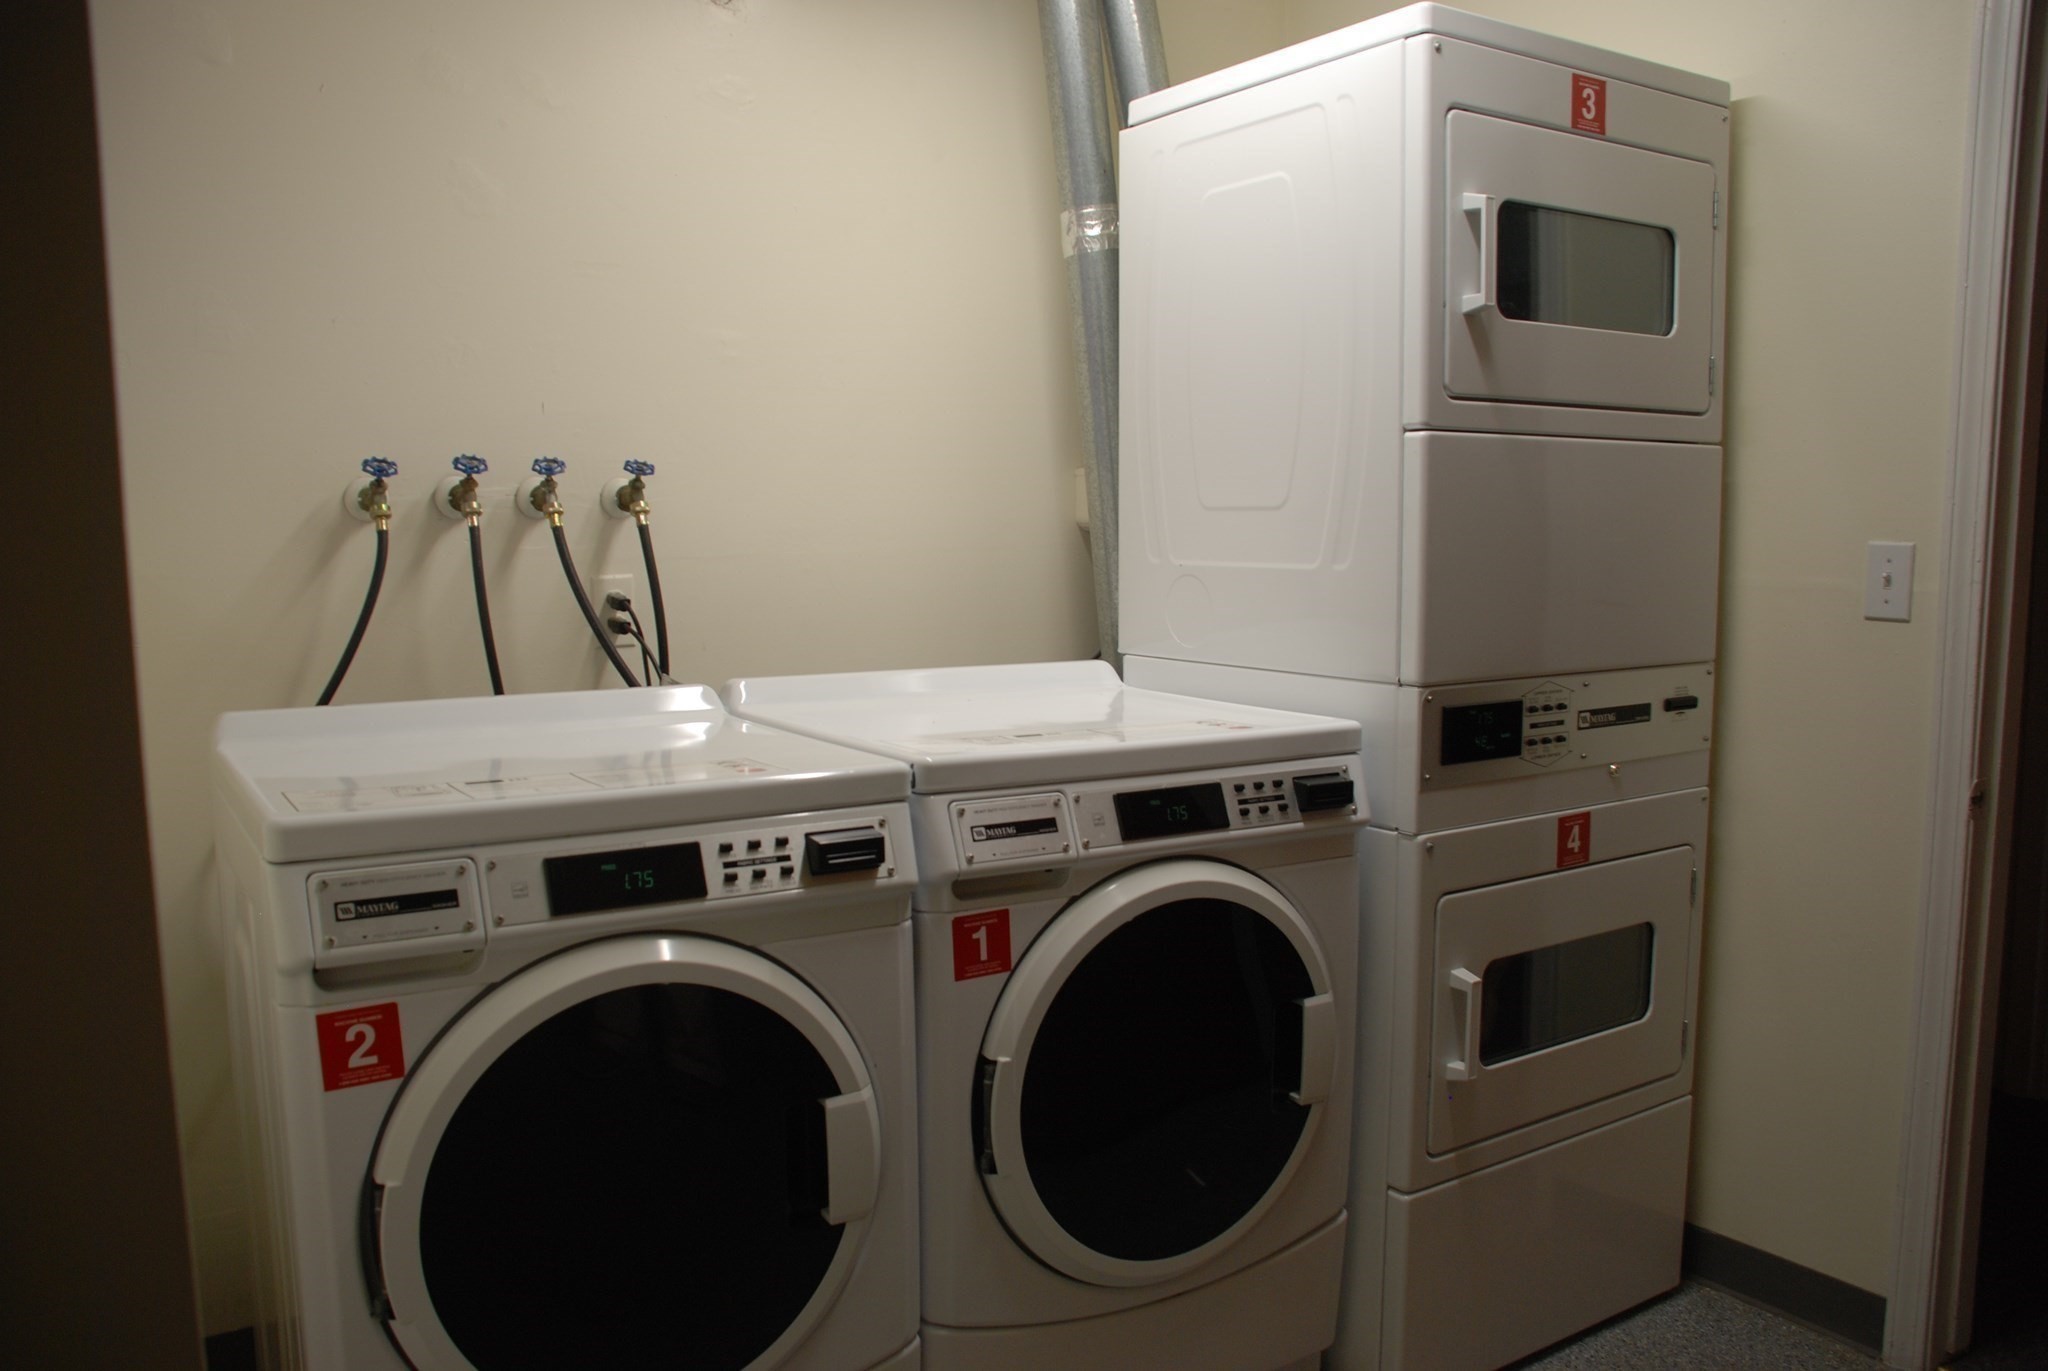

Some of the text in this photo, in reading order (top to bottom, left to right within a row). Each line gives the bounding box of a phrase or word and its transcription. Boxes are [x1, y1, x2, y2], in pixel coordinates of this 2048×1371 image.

[1582, 88, 1595, 119] 3
[986, 826, 1017, 837] MAYTAG
[1567, 825, 1581, 853] 4
[356, 901, 399, 914] MAYTAG
[972, 925, 988, 961] 1
[345, 1023, 379, 1069] 2
